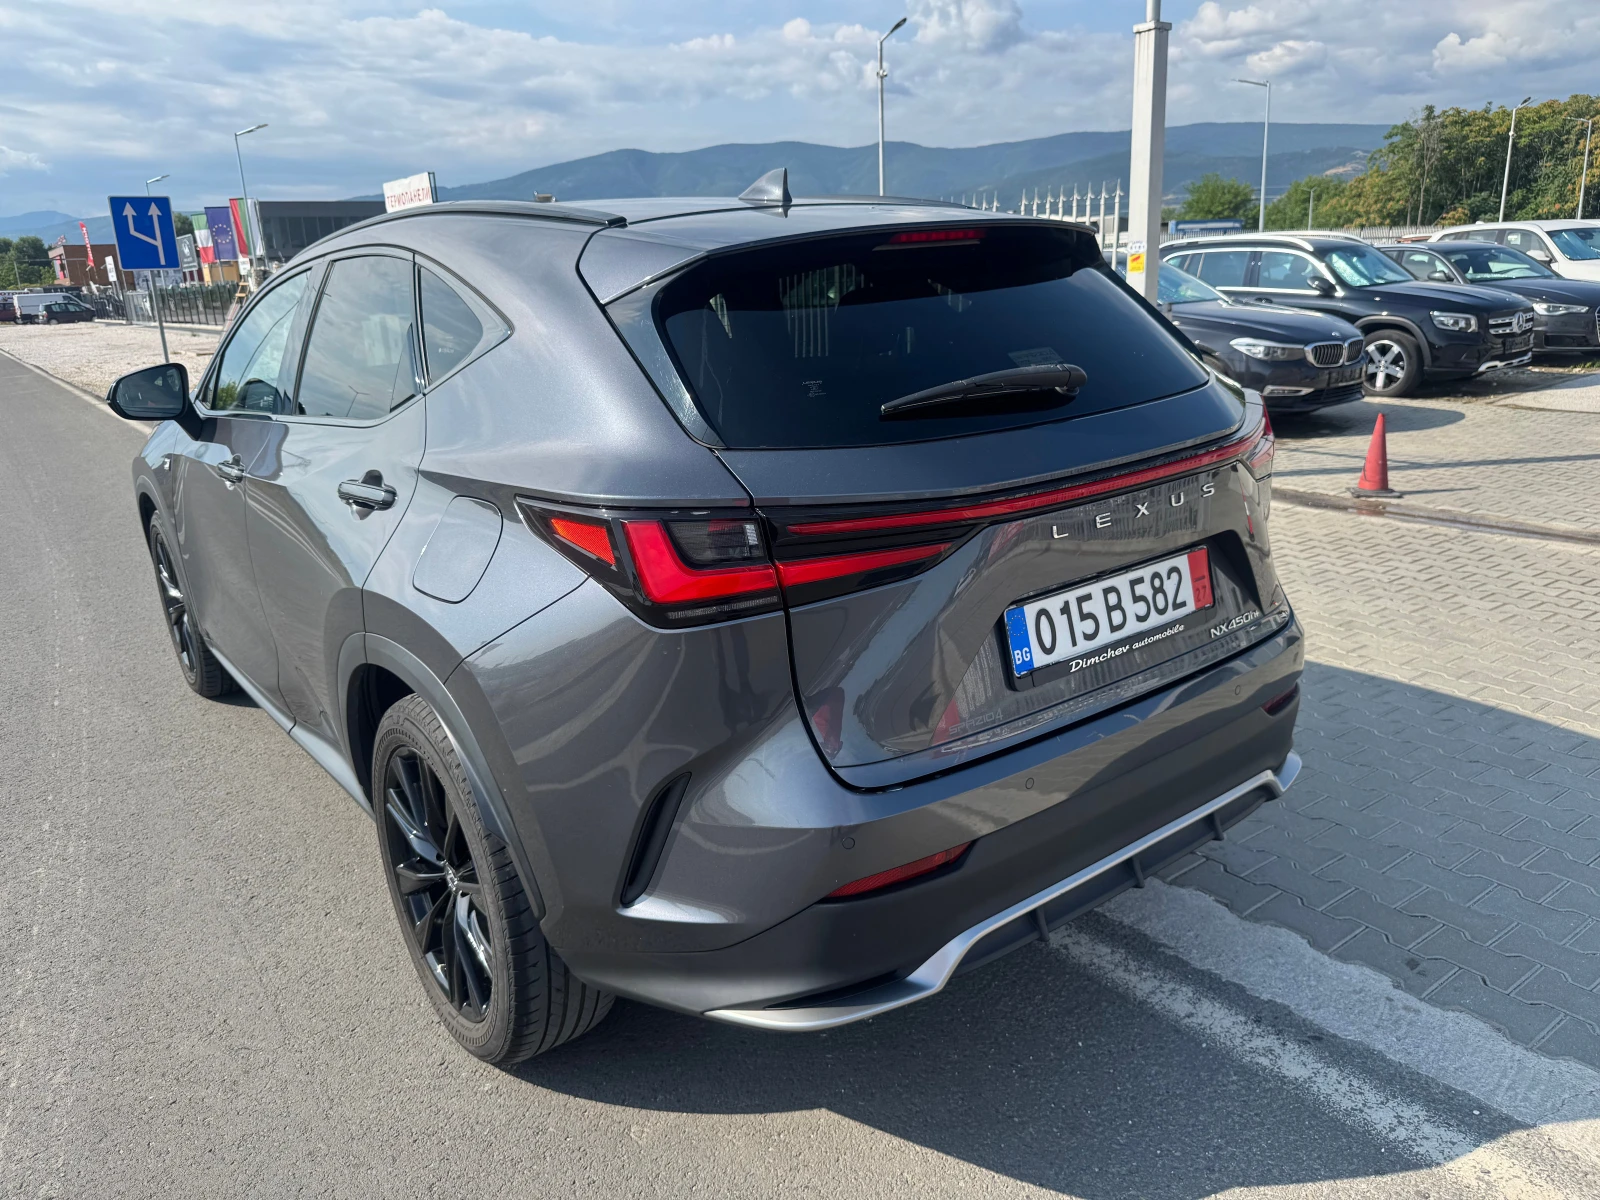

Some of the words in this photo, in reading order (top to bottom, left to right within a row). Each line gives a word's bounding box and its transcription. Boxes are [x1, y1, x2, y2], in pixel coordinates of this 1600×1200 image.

[1052, 482, 1216, 539] LEXUS
[1195, 585, 1208, 603] 27
[1014, 647, 1031, 665] BG
[1069, 643, 1130, 673] Dimchev
[1132, 623, 1185, 650] automobile
